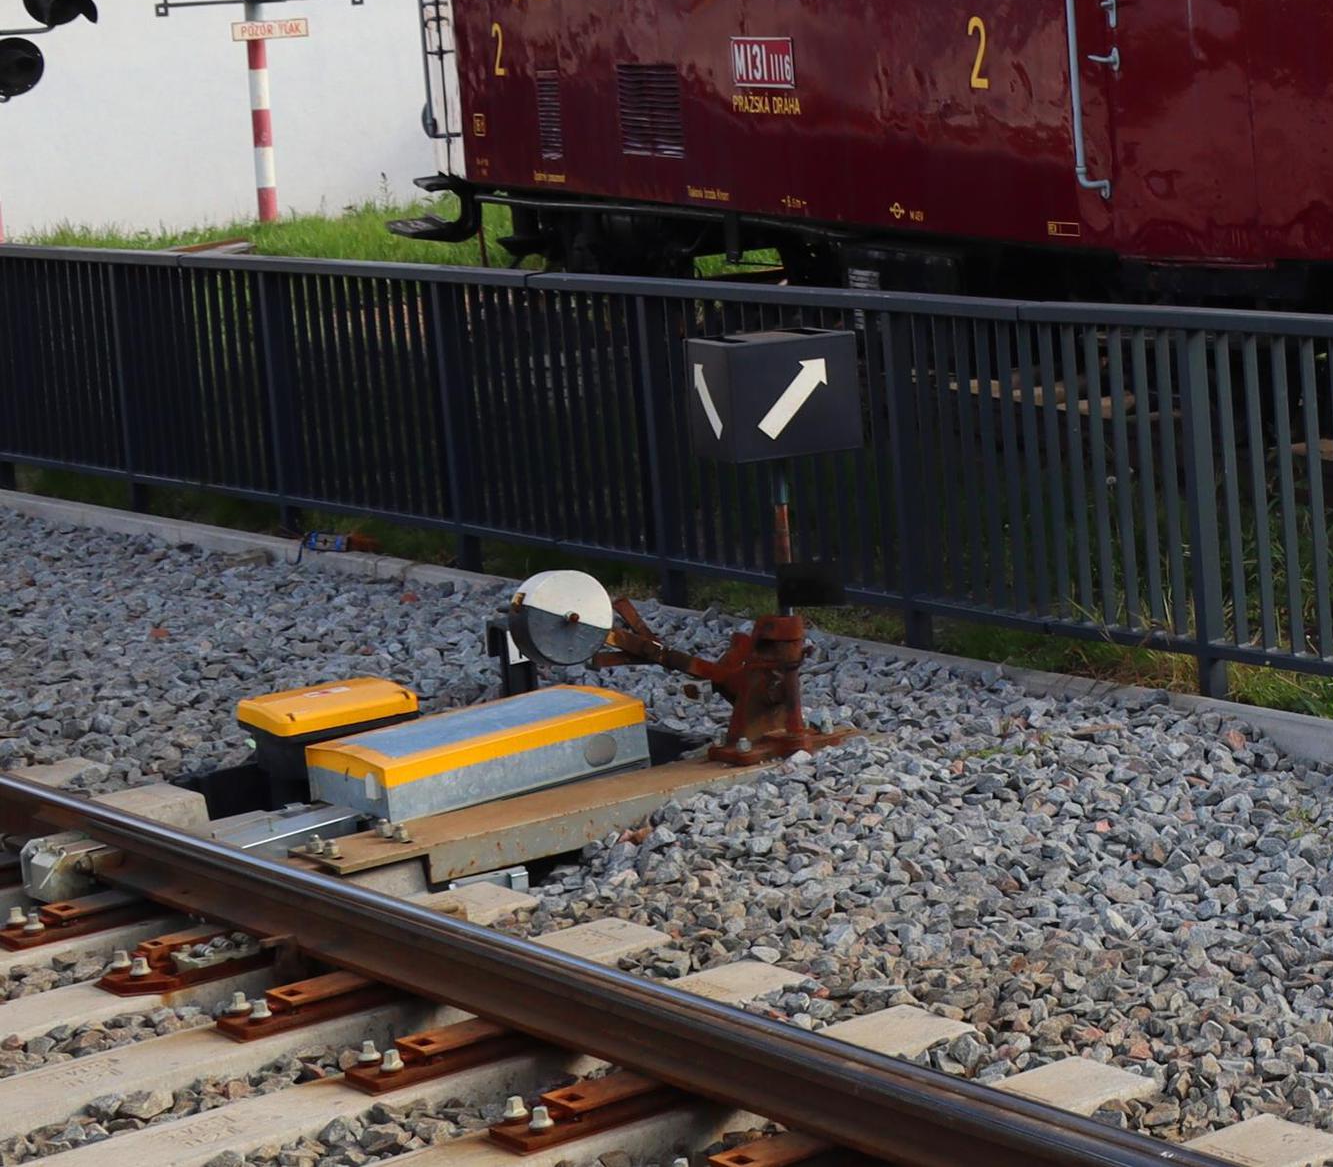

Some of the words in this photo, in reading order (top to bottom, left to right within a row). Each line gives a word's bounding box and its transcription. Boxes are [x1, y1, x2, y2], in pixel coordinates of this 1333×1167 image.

[491, 22, 505, 76] 2
[967, 16, 989, 90] 2
[732, 91, 771, 114] PRAŽSKÁ
[772, 92, 802, 115] DRÁHA
